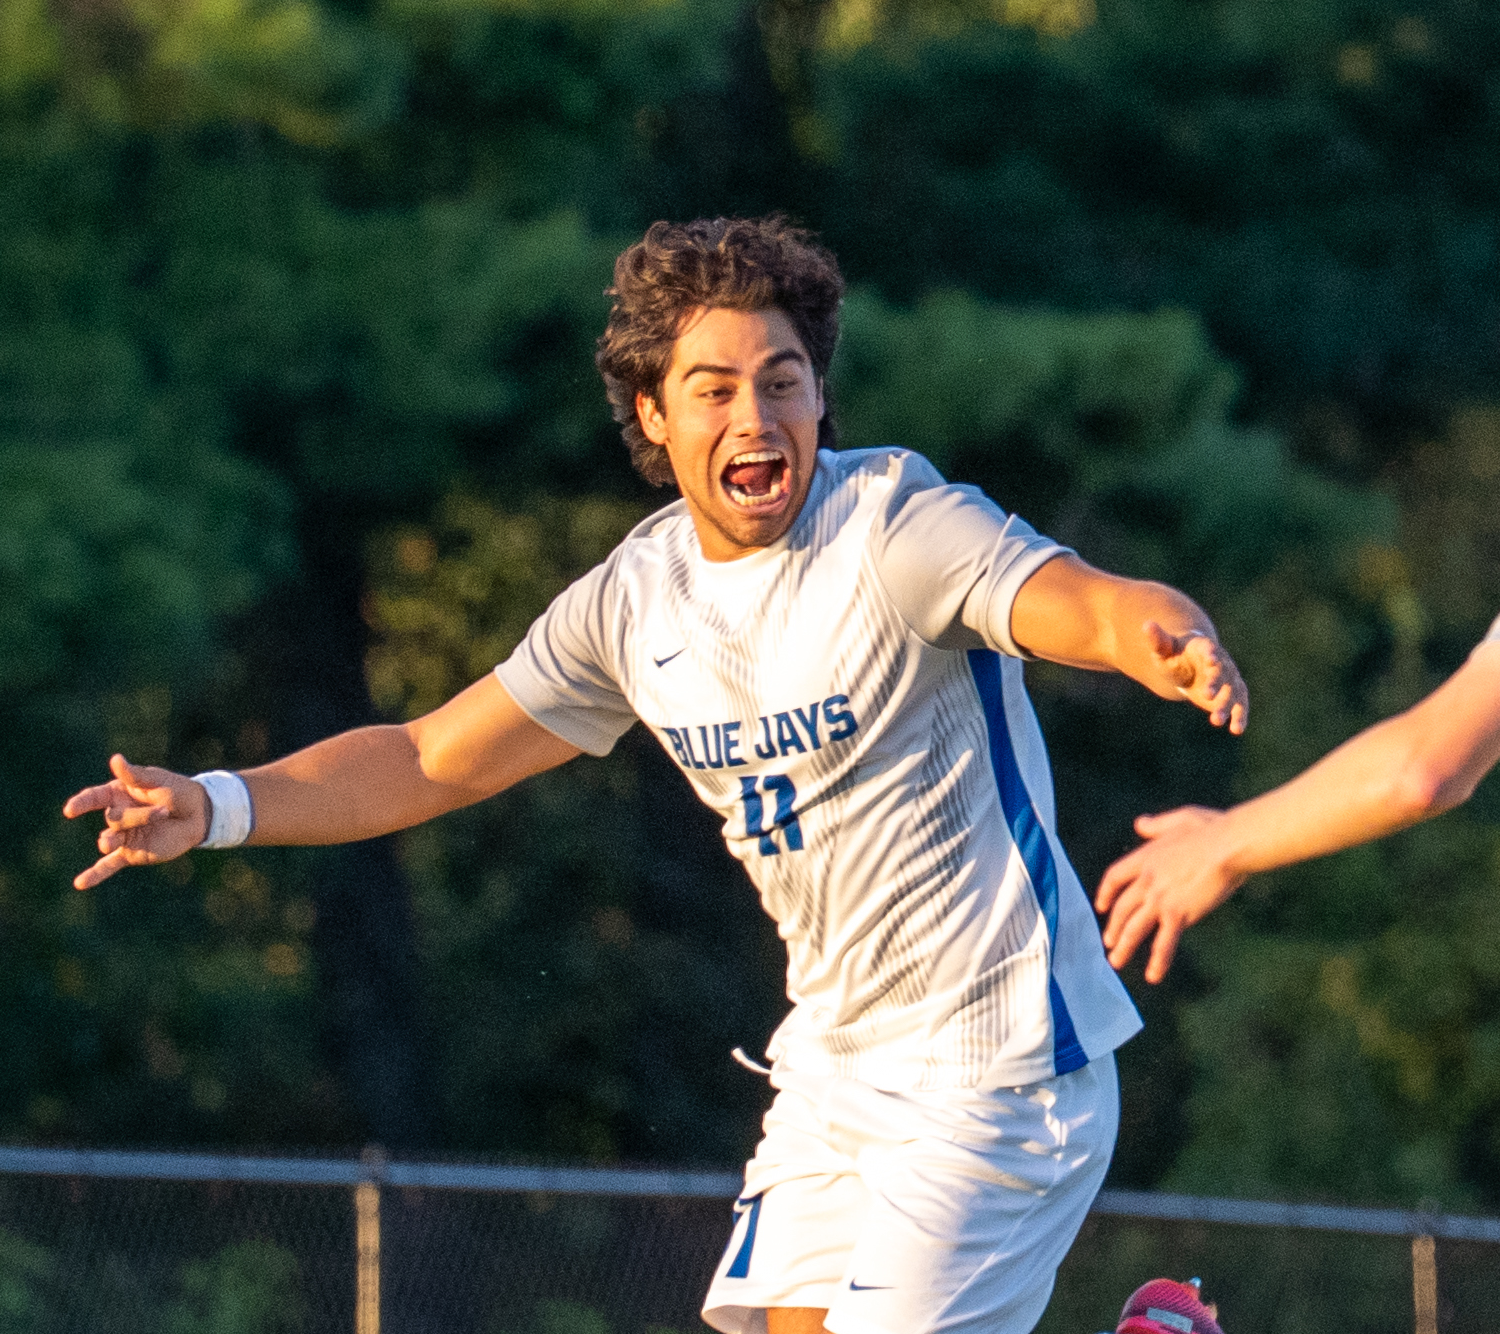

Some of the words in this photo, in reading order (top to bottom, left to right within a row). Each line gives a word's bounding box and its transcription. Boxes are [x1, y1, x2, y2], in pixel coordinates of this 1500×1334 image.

[662, 720, 749, 770] BLUE
[754, 693, 859, 761] JAYS
[738, 773, 804, 857] 11
